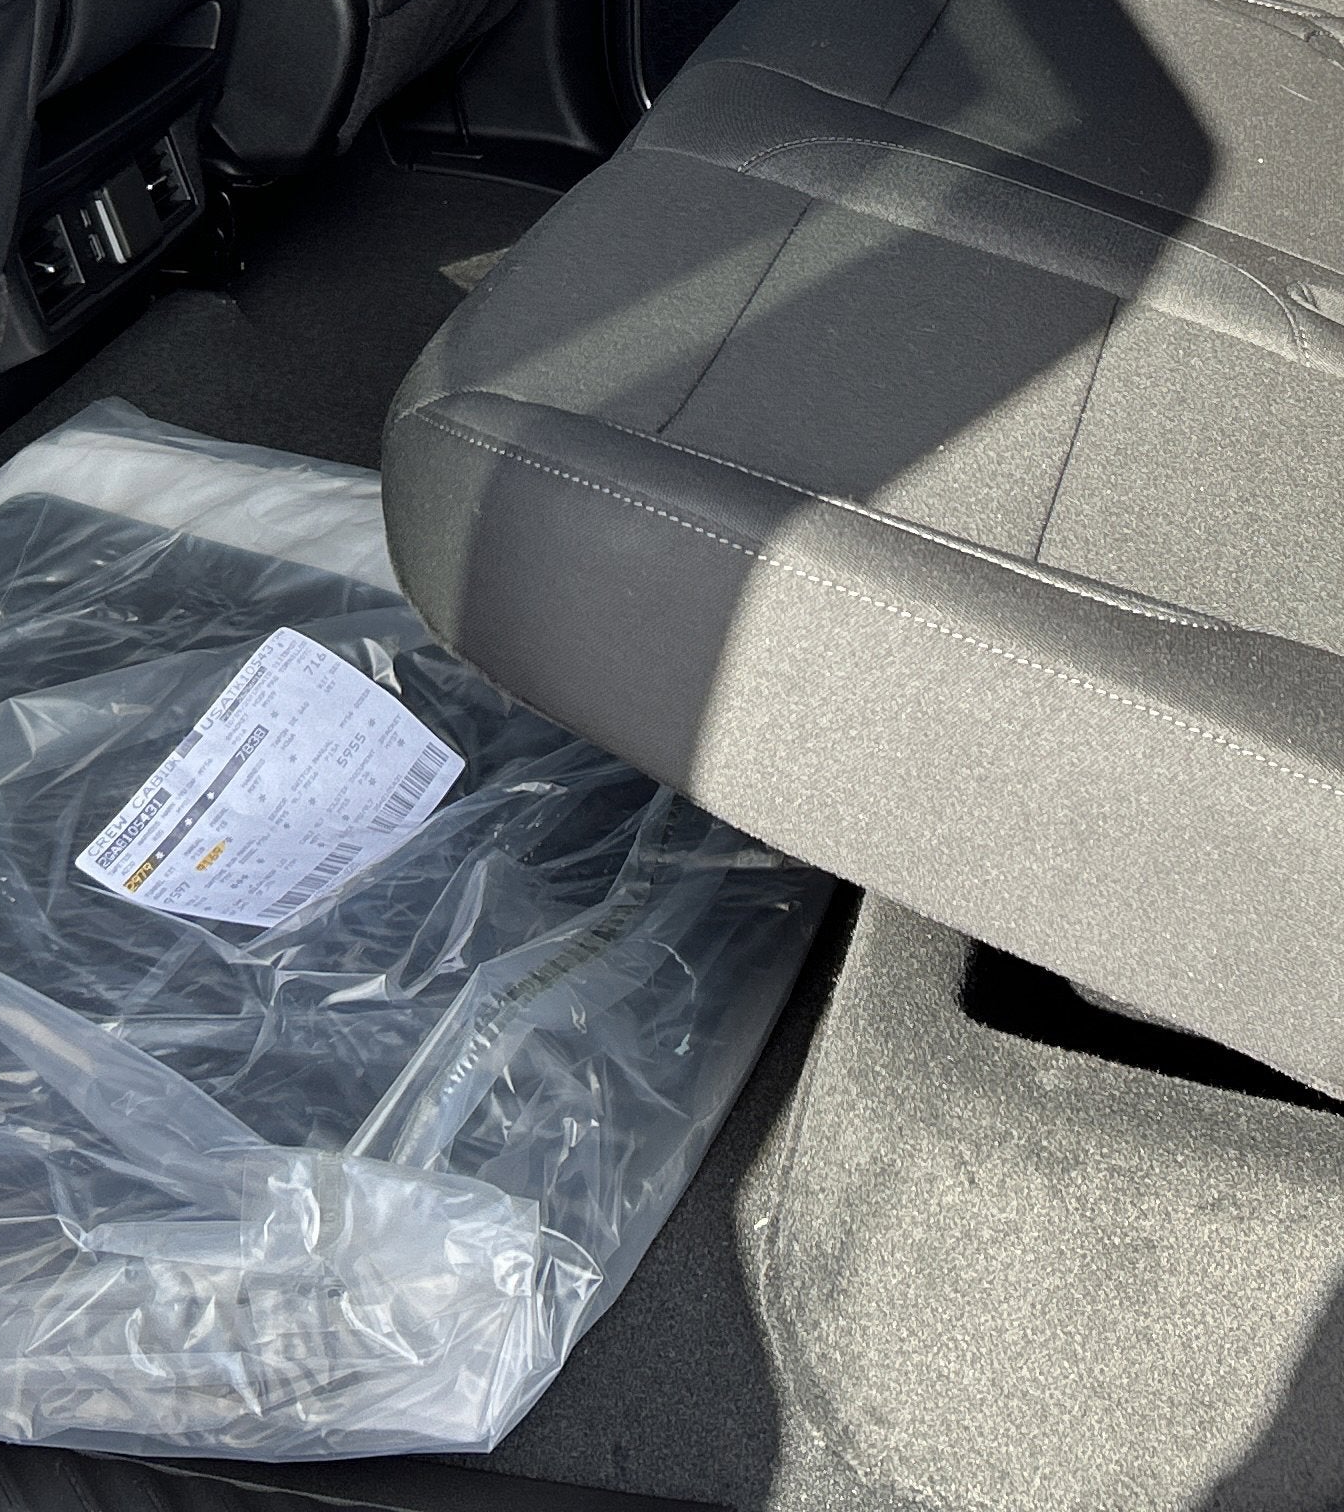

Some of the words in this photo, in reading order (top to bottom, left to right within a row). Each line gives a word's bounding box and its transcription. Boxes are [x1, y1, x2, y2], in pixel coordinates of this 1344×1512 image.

[302, 648, 328, 677] 716
[234, 726, 266, 763] 7838
[335, 730, 367, 769] 5955
[85, 814, 128, 859] CREW
[124, 860, 155, 893] 2979
[162, 879, 191, 908] 9597
